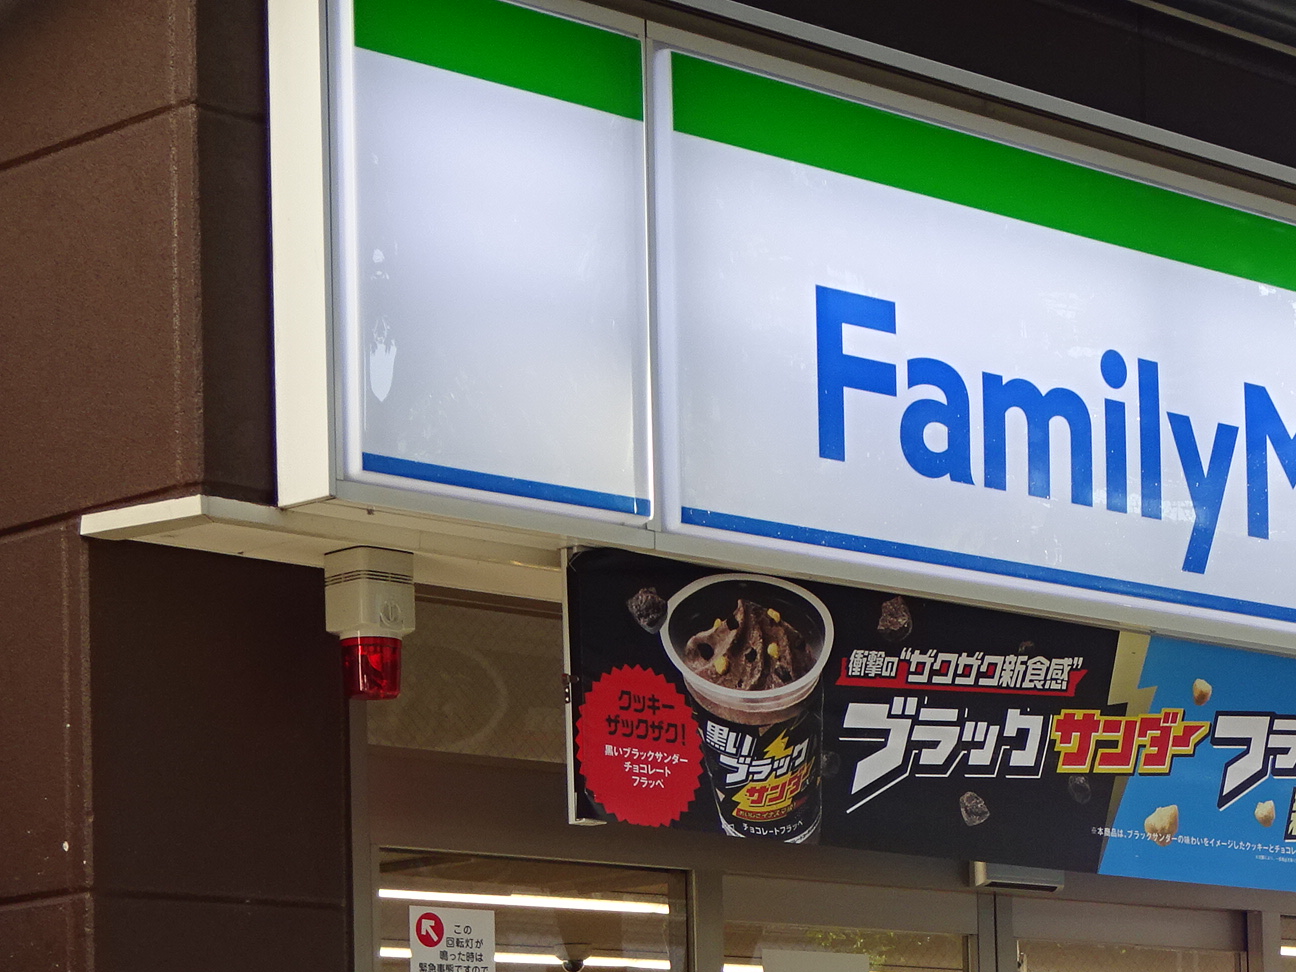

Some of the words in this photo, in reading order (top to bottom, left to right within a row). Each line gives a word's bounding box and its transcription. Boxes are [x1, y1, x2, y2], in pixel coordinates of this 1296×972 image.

[618, 689, 675, 715] クッキー
[605, 714, 686, 746] ザックザク!
[705, 720, 757, 757] 黒い
[604, 744, 689, 764] 黒いブラックサンダー
[719, 738, 810, 788] ブラック
[623, 761, 672, 777] チョコレート
[631, 776, 665, 788] フラッペ
[452, 924, 473, 936] この
[445, 937, 484, 950] 回転灯が
[439, 950, 484, 964] 鳴った時は
